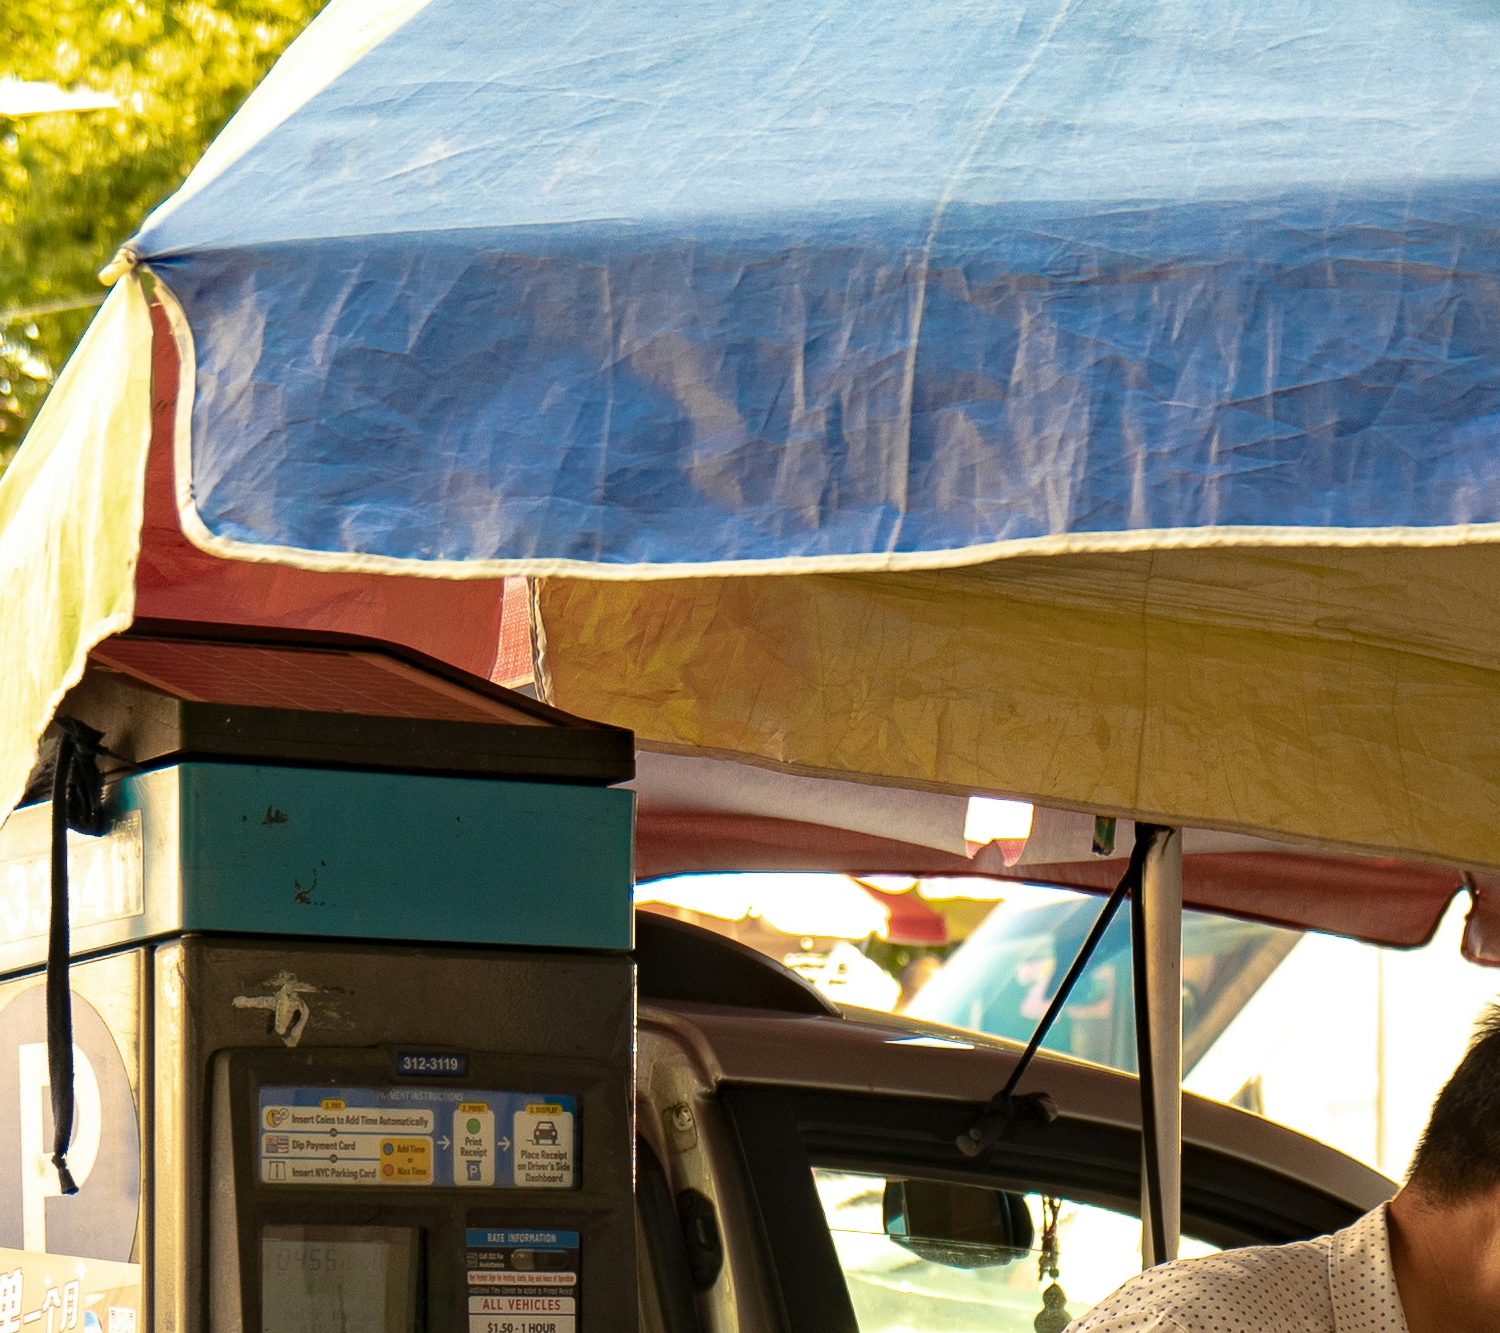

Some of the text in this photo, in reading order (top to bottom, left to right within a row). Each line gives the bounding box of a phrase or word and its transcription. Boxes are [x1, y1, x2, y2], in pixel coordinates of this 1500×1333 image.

[403, 1056, 459, 1071] 312-3119
[468, 1104, 485, 1112] PRINT
[536, 1106, 559, 1114] DISPLAY
[292, 1114, 428, 1128] Insert Coins to Add Time Automatically
[292, 1140, 356, 1152] Dip Payment Card
[465, 1137, 482, 1146] Print
[411, 1145, 425, 1153] Time
[460, 1147, 487, 1157] Receipt
[520, 1150, 567, 1160] Place Receipt
[397, 1167, 427, 1175] Max Time
[528, 1162, 555, 1171] Driver's
[556, 1162, 570, 1171] Side
[292, 1167, 377, 1180] Insert NYC Parking Card
[525, 1173, 563, 1183] Dashboard
[487, 1233, 556, 1243] RATE INFORMATION
[483, 1299, 561, 1311] ALL VEHICLES
[488, 1323, 513, 1333] $1.50
[529, 1323, 556, 1333] HOUR
